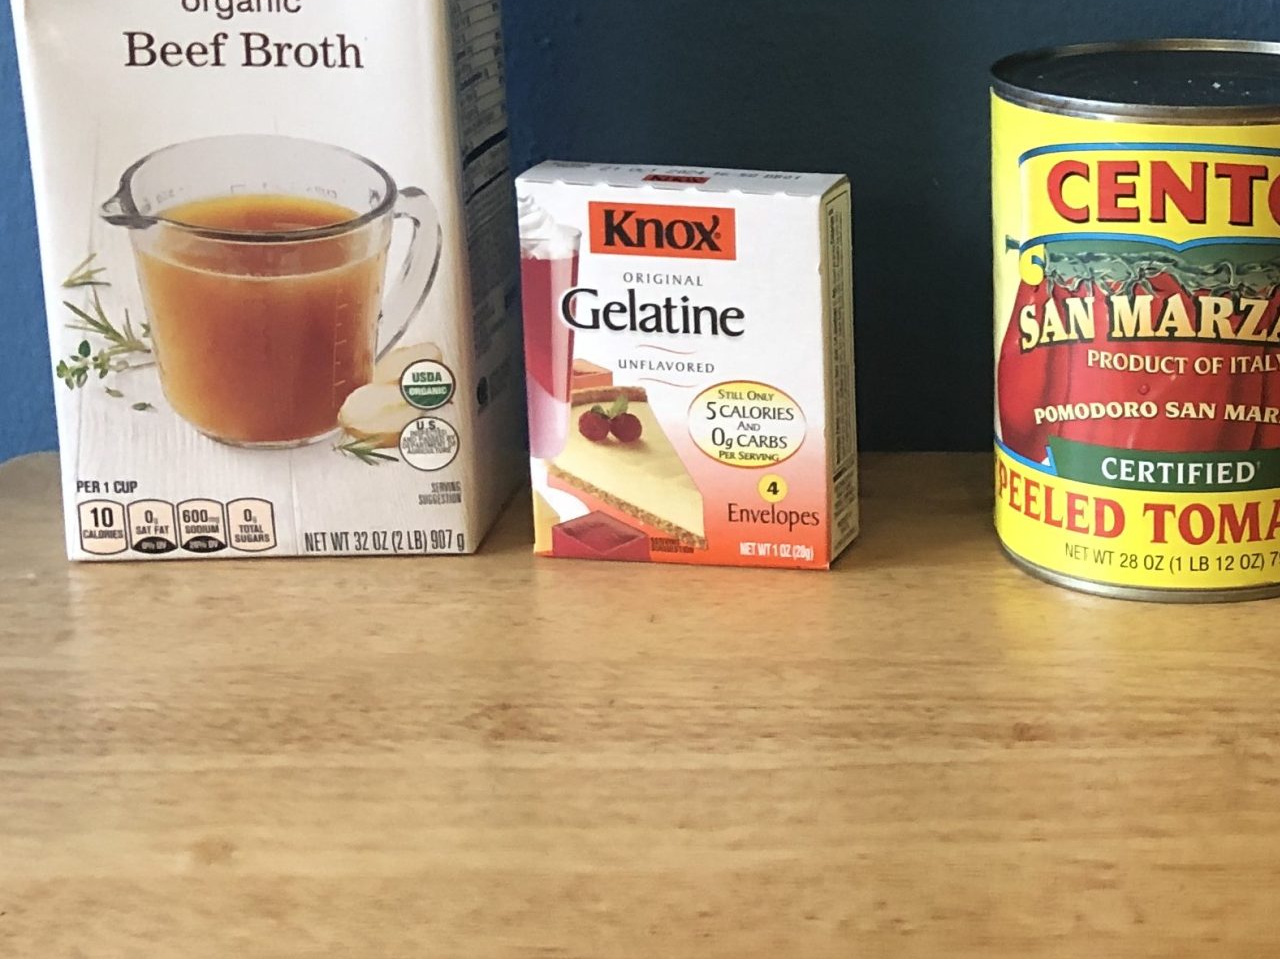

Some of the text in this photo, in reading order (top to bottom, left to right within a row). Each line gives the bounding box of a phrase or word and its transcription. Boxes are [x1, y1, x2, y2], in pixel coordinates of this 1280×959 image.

[122, 31, 364, 69] Beef Broth
[603, 209, 722, 252] Knox
[623, 272, 703, 286] ORIGINAL
[561, 288, 745, 337] Gelatine
[1020, 295, 1096, 350] SAN
[618, 359, 715, 374] UNFLAVORED
[1087, 349, 1188, 374] PRODUCT
[1194, 356, 1223, 375] OF
[412, 371, 442, 383] USDA
[408, 386, 448, 396] ORGANIC
[706, 401, 794, 421] 5 CALORIES
[1034, 401, 1158, 425] POMODORO
[1165, 401, 1216, 419] SAN
[711, 427, 788, 450] 0g CARBS
[1101, 457, 1256, 485] CERTIFIED
[76, 480, 138, 493] PER 1 CUP
[431, 481, 461, 492] SERVING
[766, 481, 780, 495] 4
[418, 493, 461, 505] SUGGESTION
[998, 458, 1126, 539] PEELED
[90, 507, 114, 528] 10
[728, 503, 820, 531] Envelopes
[83, 530, 124, 539] CALORIES
[136, 525, 169, 535] SAT FAT
[185, 525, 220, 534] SODIUM
[239, 525, 264, 533] TOTAL
[235, 534, 270, 542] SUGARS
[305, 530, 465, 553] NET WT 32 OZ (2 LB) 907 g
[740, 542, 756, 555] NET
[758, 543, 771, 556] WT
[772, 544, 778, 556] 1
[1065, 542, 1090, 561] NET
[1093, 550, 1115, 566] WT
[1119, 553, 1138, 569] 28
[1144, 555, 1164, 571] OZ
[1169, 555, 1182, 574] (1
[1190, 556, 1209, 571] LB
[1216, 556, 1235, 571] 12
[1240, 552, 1265, 572] OZ)
